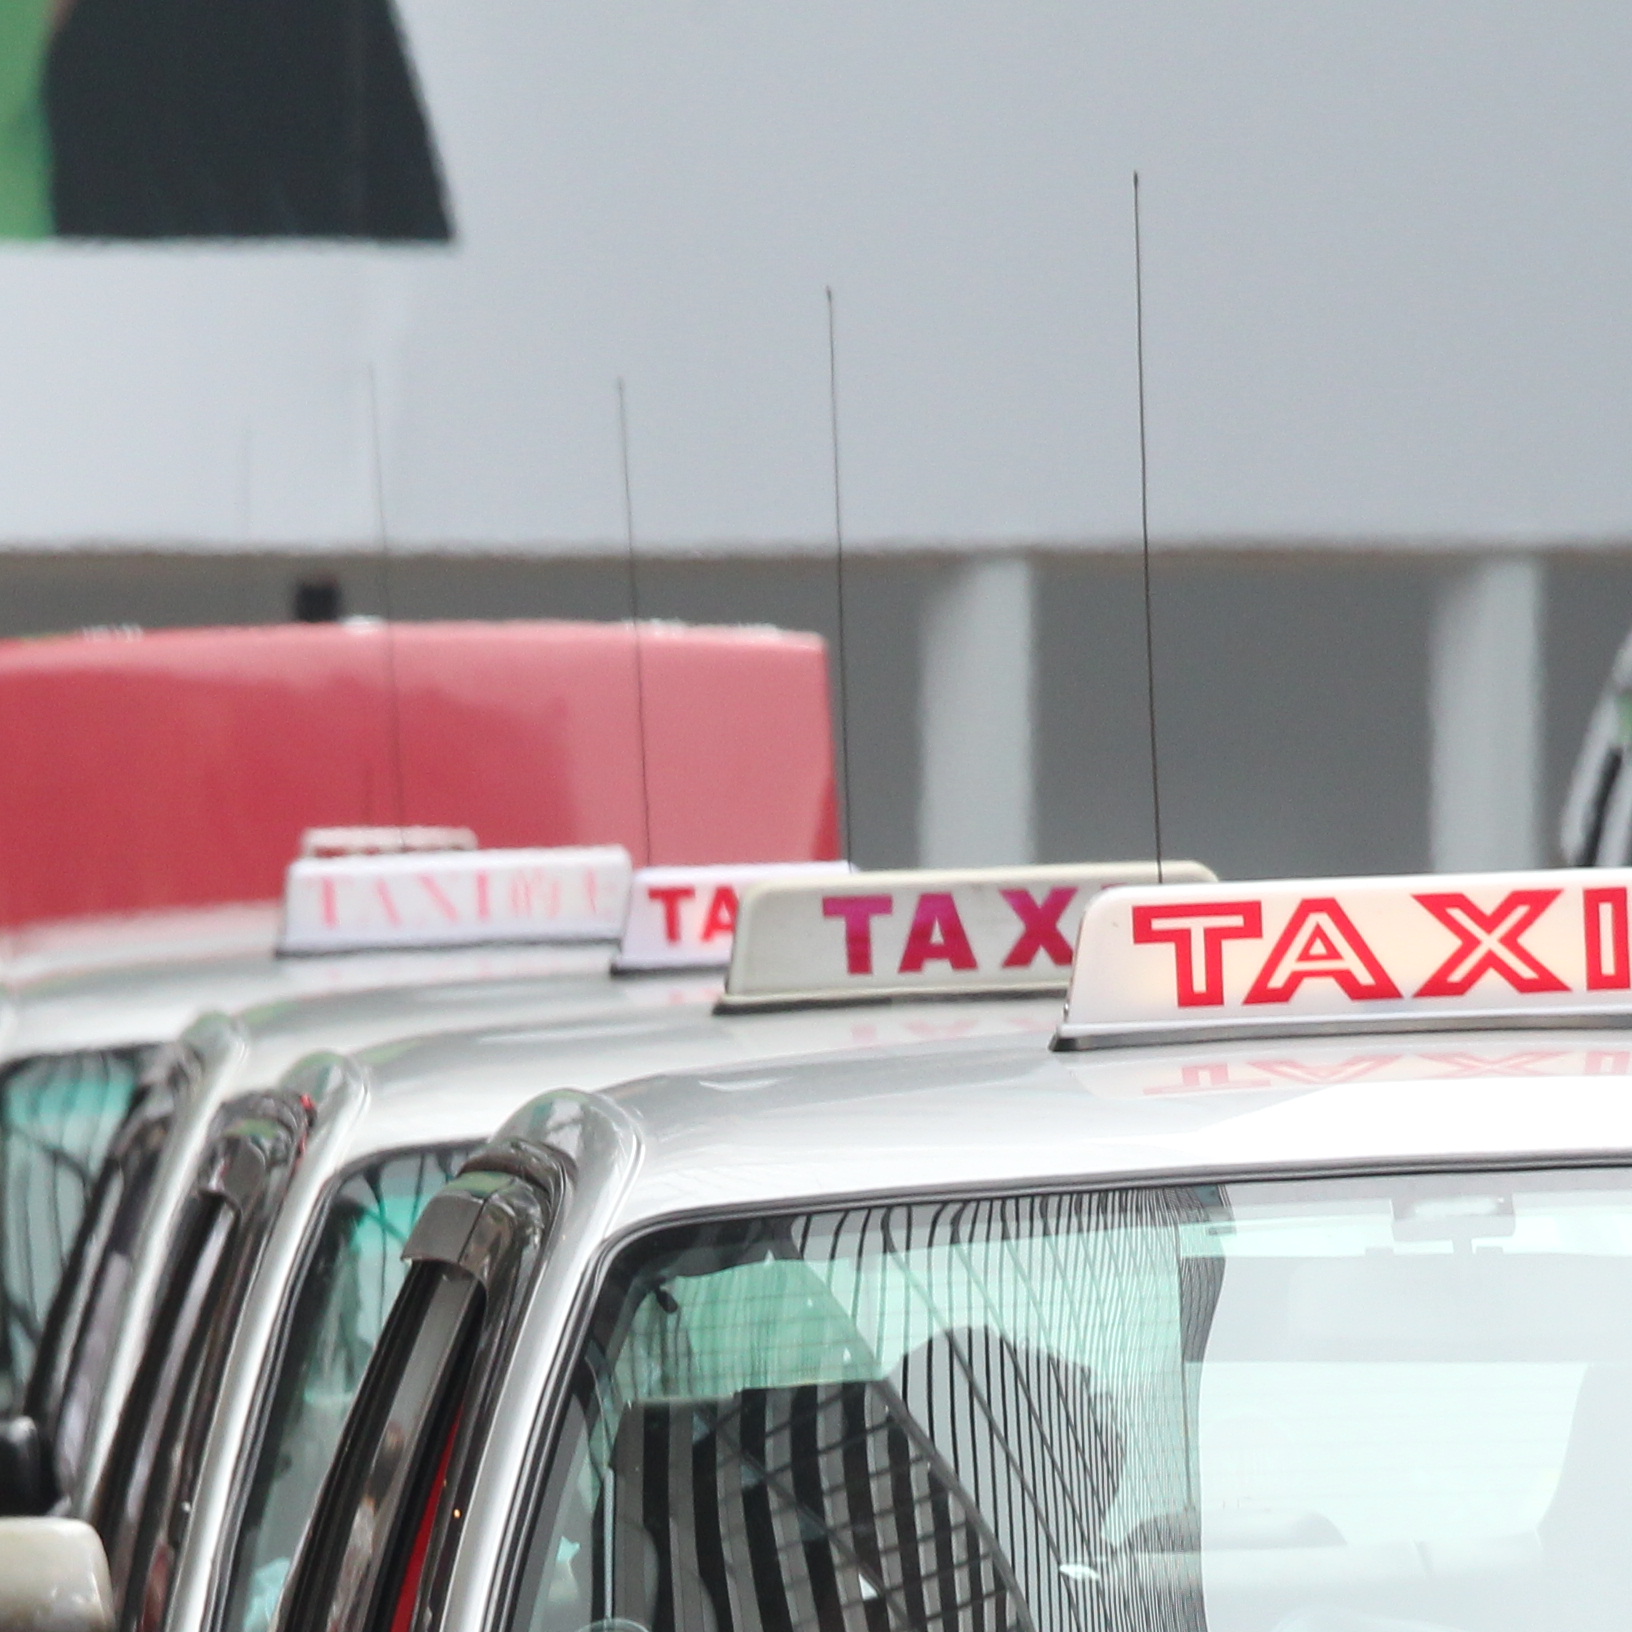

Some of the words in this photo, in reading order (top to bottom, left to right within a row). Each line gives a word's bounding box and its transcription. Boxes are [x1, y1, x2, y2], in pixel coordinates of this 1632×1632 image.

[648, 884, 739, 944] TA
[822, 884, 1080, 976] TAX
[1132, 887, 1631, 1008] TAXI
